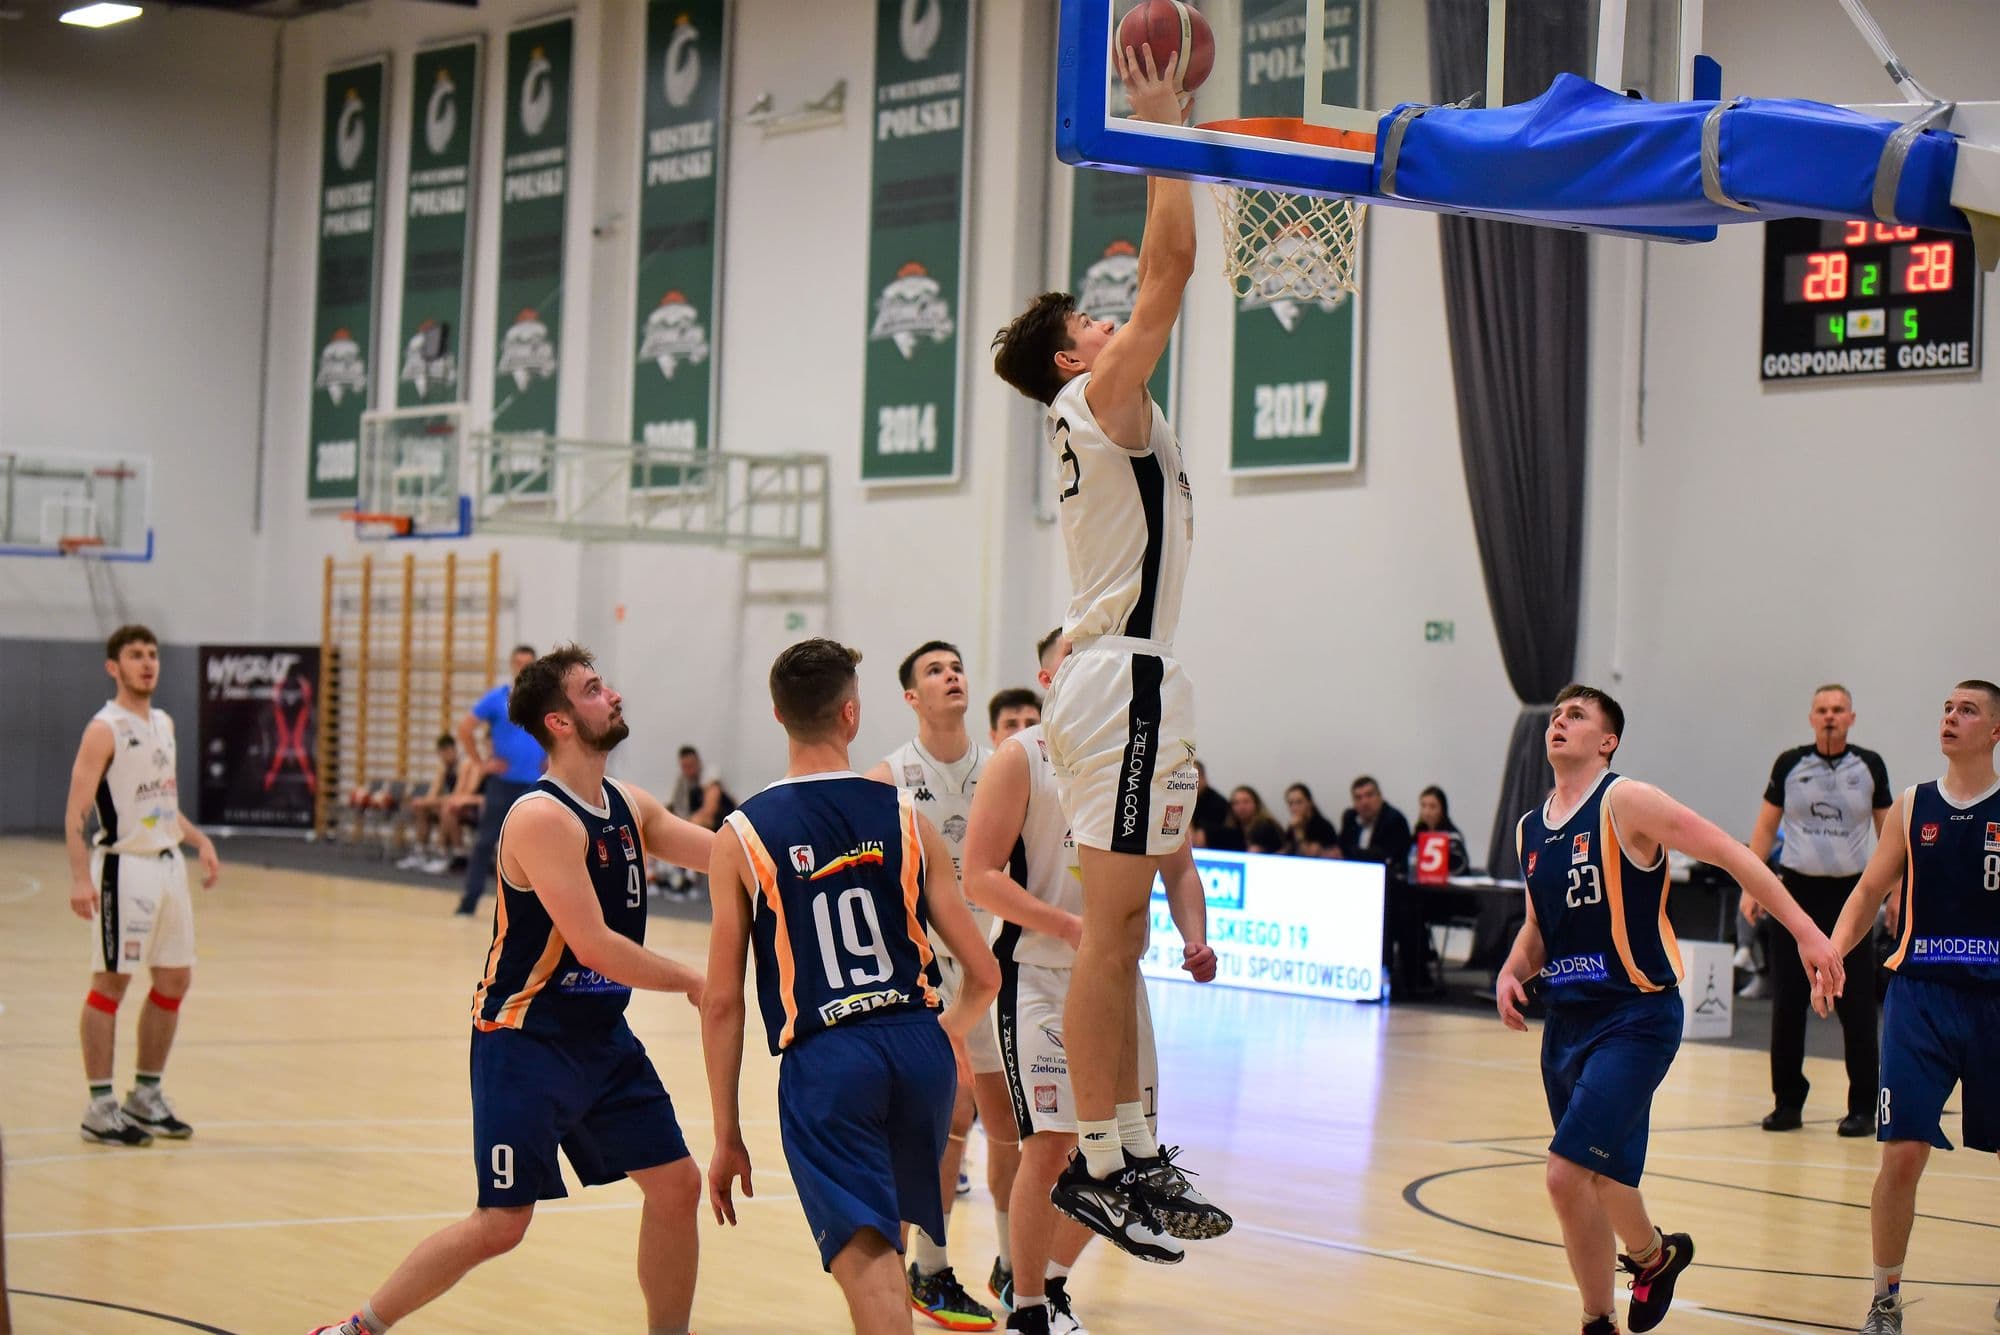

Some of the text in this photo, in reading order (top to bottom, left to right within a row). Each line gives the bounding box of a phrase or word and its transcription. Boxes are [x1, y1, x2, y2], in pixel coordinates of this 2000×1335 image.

[878, 98, 960, 141] POLSKI
[1803, 242, 1953, 301] 28 2 28
[1829, 308, 1918, 343] 4 5
[1764, 339, 1969, 377] GOSPODARZE GOŚCIE
[878, 403, 936, 455] 2014
[1254, 379, 1328, 441] 2017
[1053, 416, 1080, 502] 3
[1122, 732, 1147, 837] ZIELONA GÓRA
[1167, 780, 1195, 790] Zielona
[1420, 837, 1445, 872] 5
[1984, 854, 2000, 891] 8
[627, 864, 640, 908] 9
[1566, 865, 1601, 908] 23
[812, 887, 894, 990] 19
[1206, 917, 1308, 948] LSKIEGO 19
[1930, 938, 1999, 955] MODERN
[1249, 955, 1372, 992] SPORTOWEGO
[1551, 955, 1604, 976] ODERN
[1003, 1026, 1017, 1086] ZIELONA
[1030, 1064, 1067, 1075] Zielona
[1880, 1087, 1891, 1125] 8
[1084, 1132, 1107, 1141] 4F
[491, 1143, 515, 1190] 9
